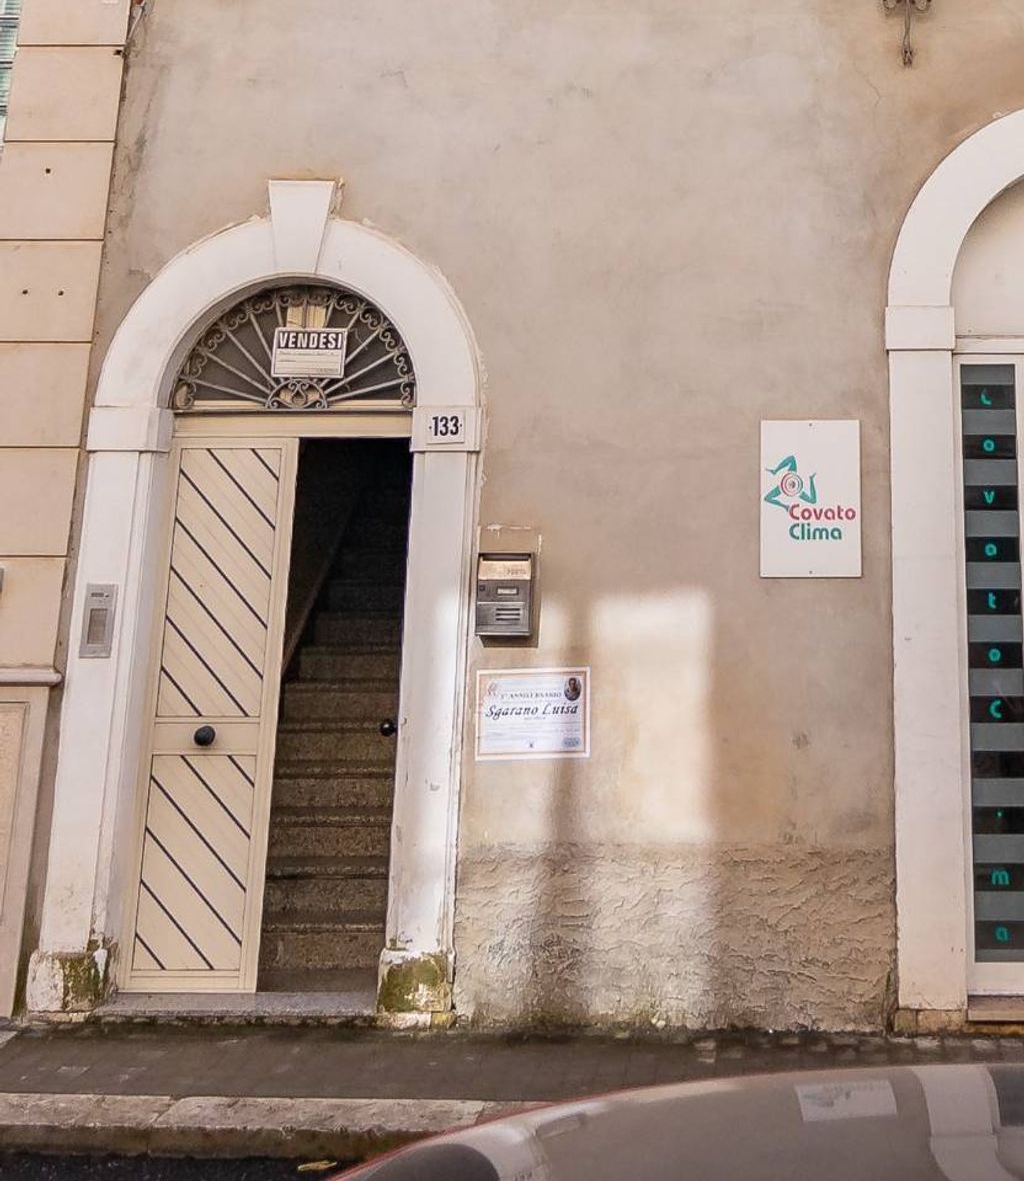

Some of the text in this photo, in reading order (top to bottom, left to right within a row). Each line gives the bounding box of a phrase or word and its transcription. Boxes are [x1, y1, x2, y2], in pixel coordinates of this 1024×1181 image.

[279, 331, 343, 349] VENDESI
[432, 415, 459, 437] 133
[788, 503, 857, 521] Covato
[788, 522, 843, 541] Clima
[485, 701, 579, 721] Sgarano Luisa
